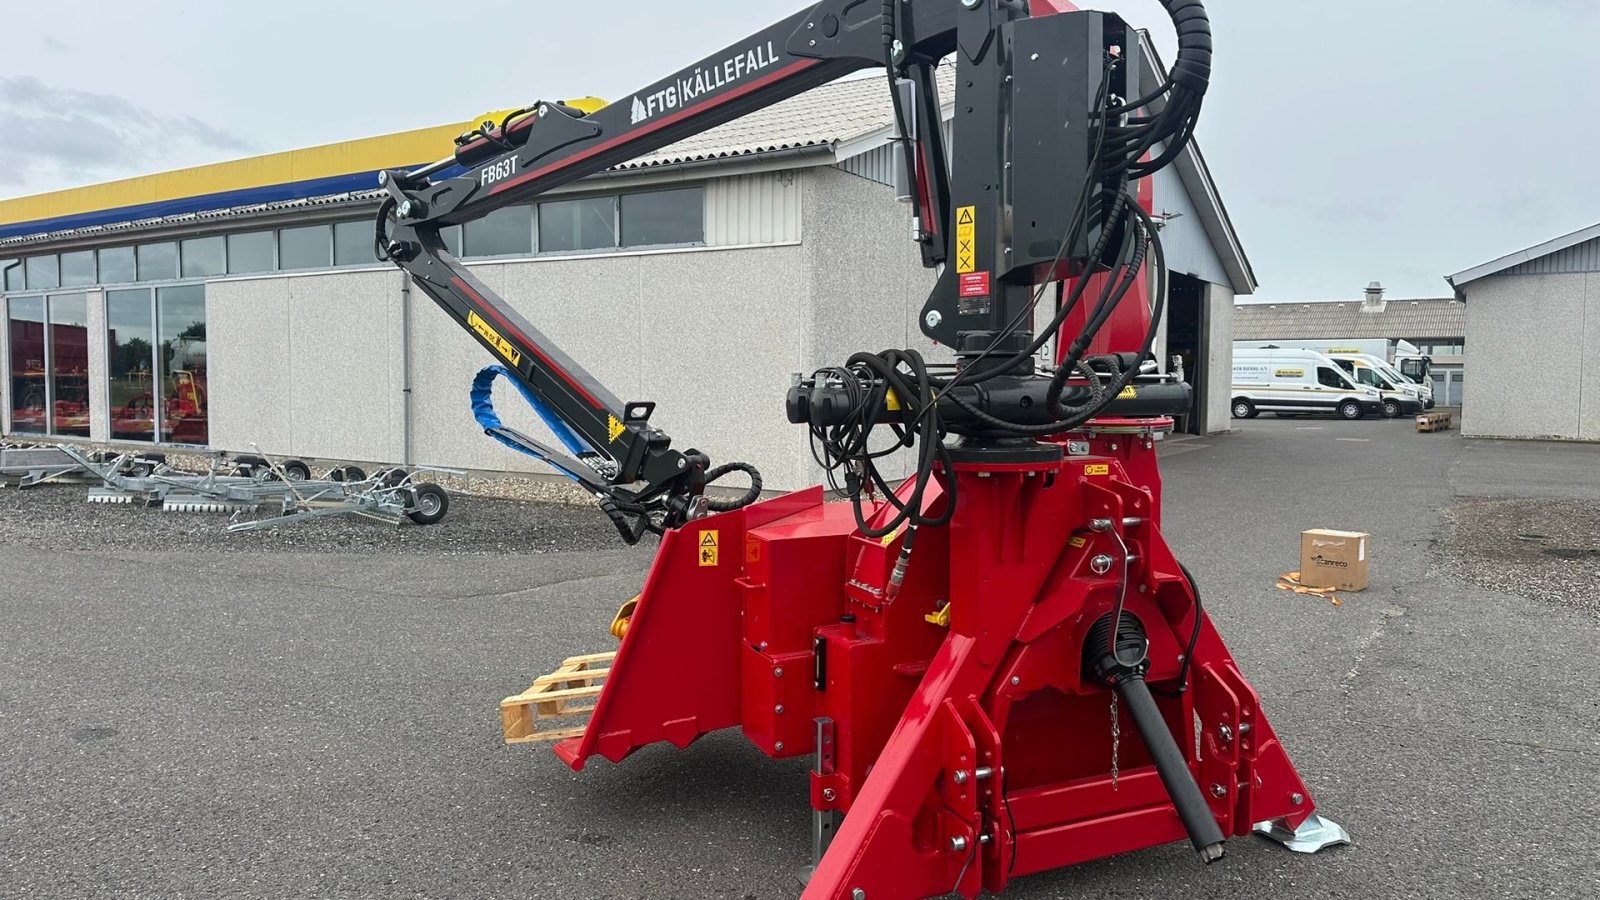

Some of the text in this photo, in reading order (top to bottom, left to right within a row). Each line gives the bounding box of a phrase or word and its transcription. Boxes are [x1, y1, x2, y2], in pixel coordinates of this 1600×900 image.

[646, 40, 780, 117] FTG KÄLLEFALL
[480, 154, 518, 187] FB63T
